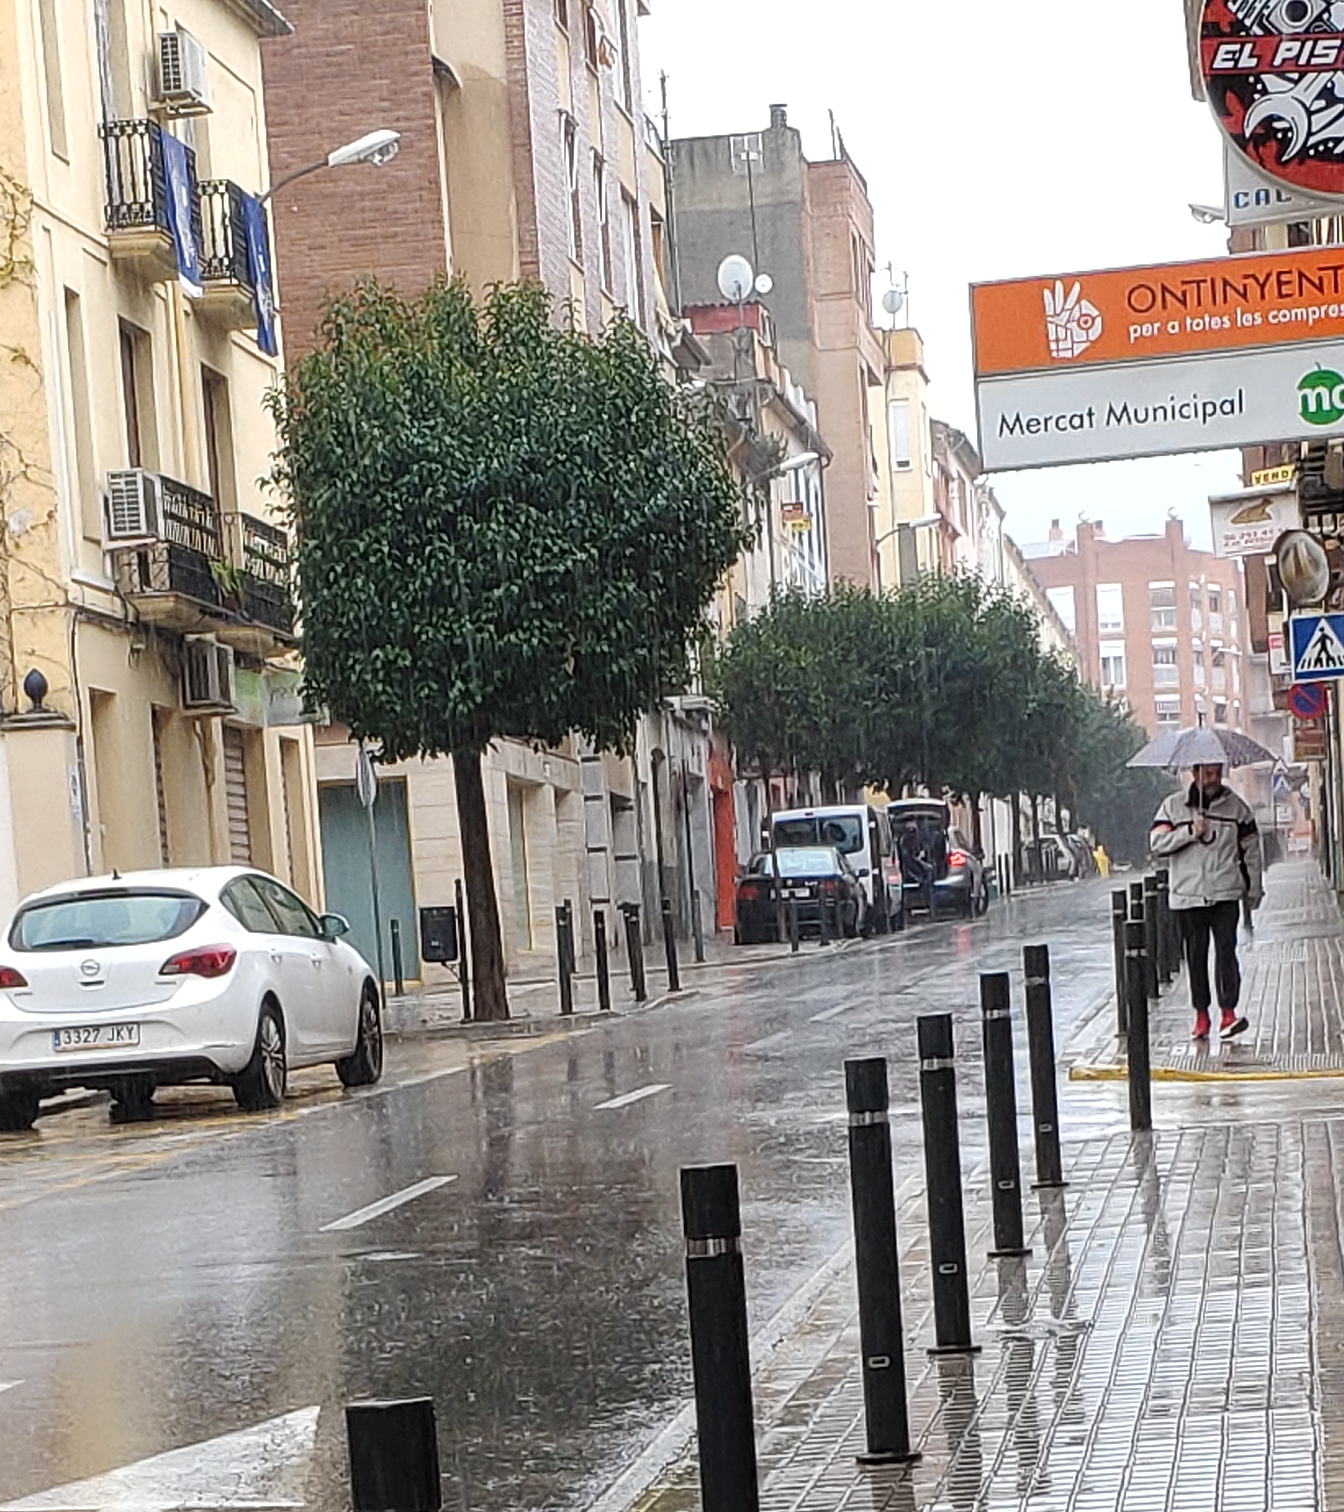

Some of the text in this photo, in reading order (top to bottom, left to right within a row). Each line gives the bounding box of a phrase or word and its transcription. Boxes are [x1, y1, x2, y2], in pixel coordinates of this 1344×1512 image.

[1212, 43, 1258, 69] EL
[1127, 264, 1344, 313] ONTINYENT
[1129, 322, 1161, 344] per
[1167, 321, 1179, 334] a
[1186, 313, 1231, 332] totes
[998, 388, 1244, 438] Mercat Municipal
[64, 1026, 134, 1044] 3327 JKY
